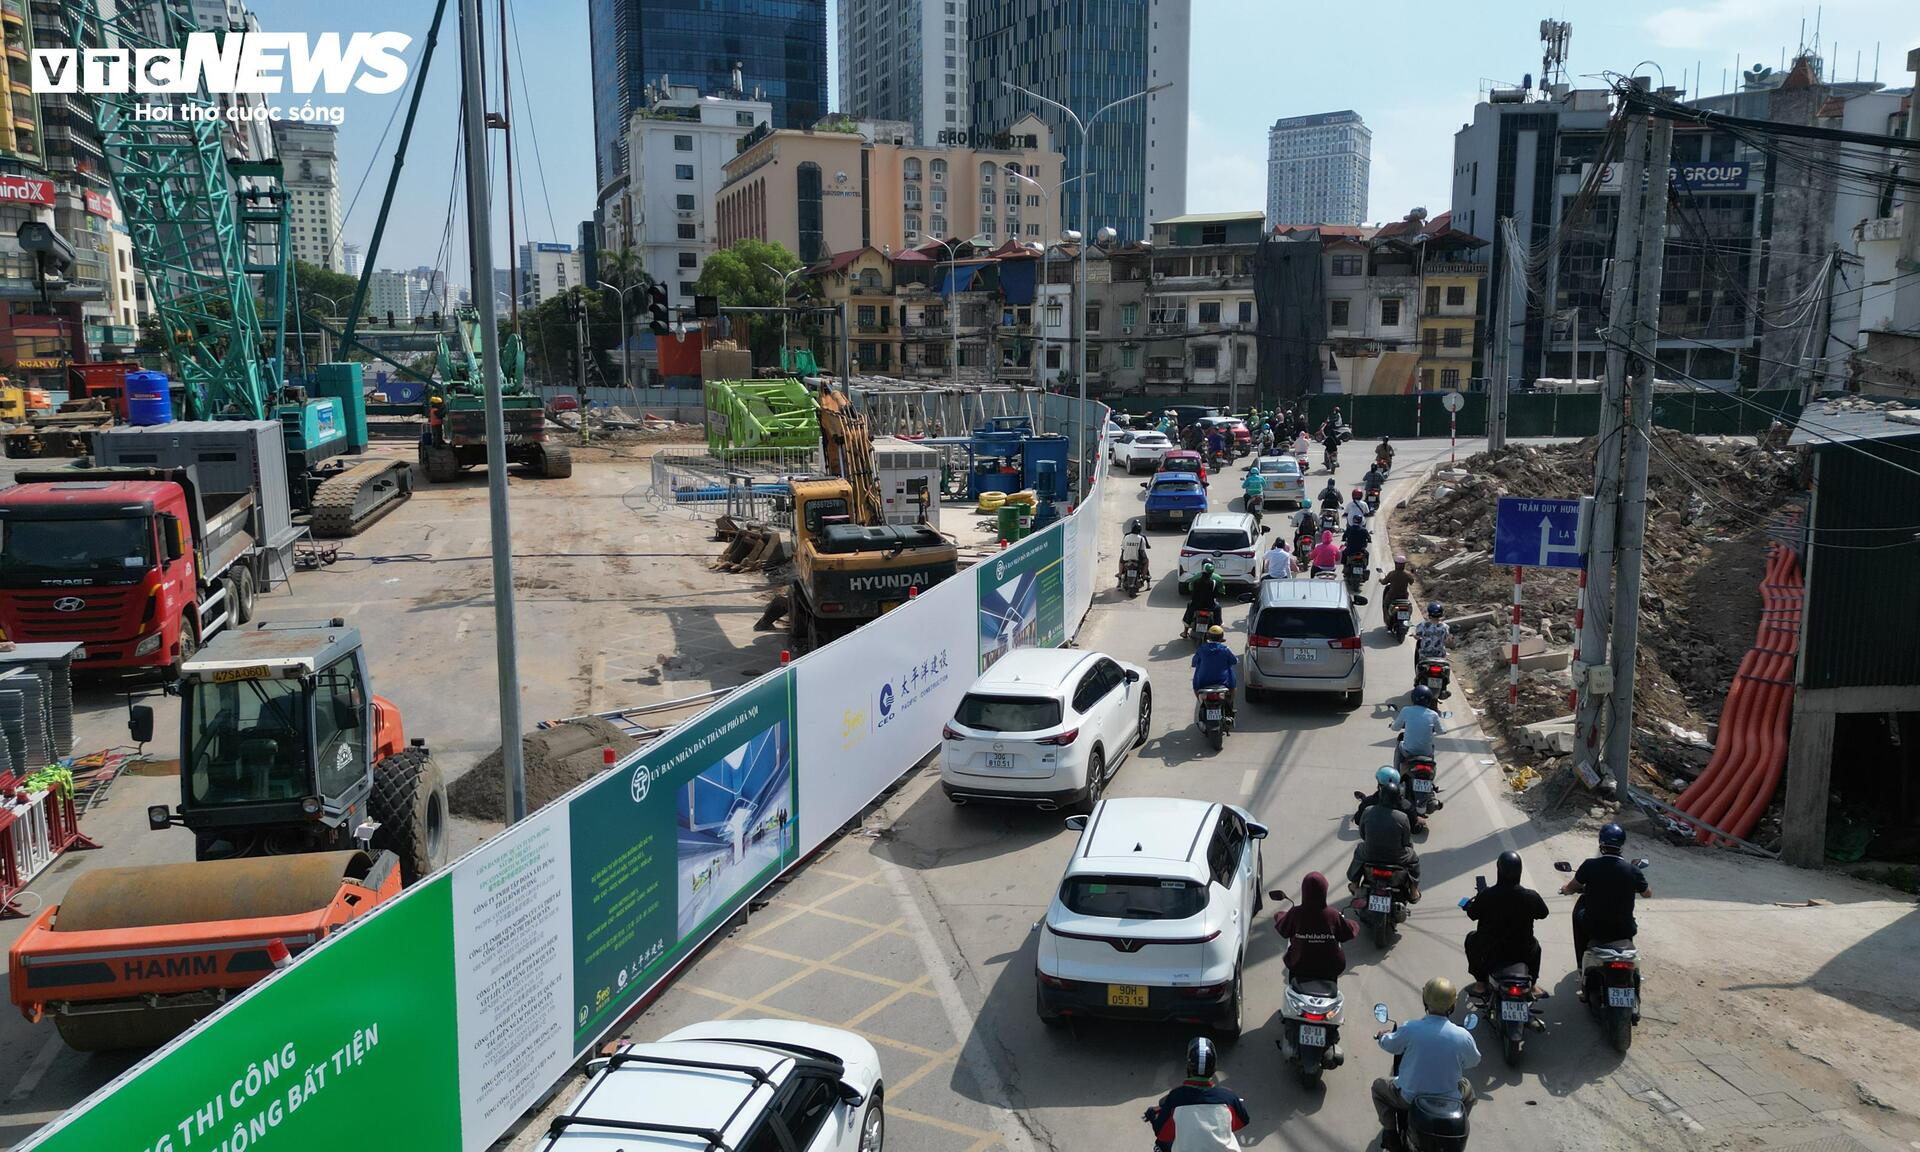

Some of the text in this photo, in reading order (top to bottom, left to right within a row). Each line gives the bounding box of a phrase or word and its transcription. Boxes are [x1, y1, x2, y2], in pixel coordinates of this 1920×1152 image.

[1684, 167, 1743, 182] GROUP
[0, 181, 45, 201] indX
[1542, 504, 1557, 512] DUY
[1559, 530, 1569, 538] LA
[850, 571, 929, 591] HYUNDAI
[661, 759, 674, 774] BAN
[675, 747, 692, 765] NHÂN
[693, 738, 705, 753] DÂN
[707, 725, 726, 745] THÀNH
[739, 711, 747, 724] HÀ
[124, 954, 217, 980] HAMM
[1112, 994, 1144, 1006] 053.15
[1119, 985, 1137, 995] 90H
[287, 1064, 328, 1114] BẤT
[331, 1023, 379, 1076] TIỆN
[178, 1095, 224, 1146] THI
[229, 1042, 297, 1108] CÔNG
